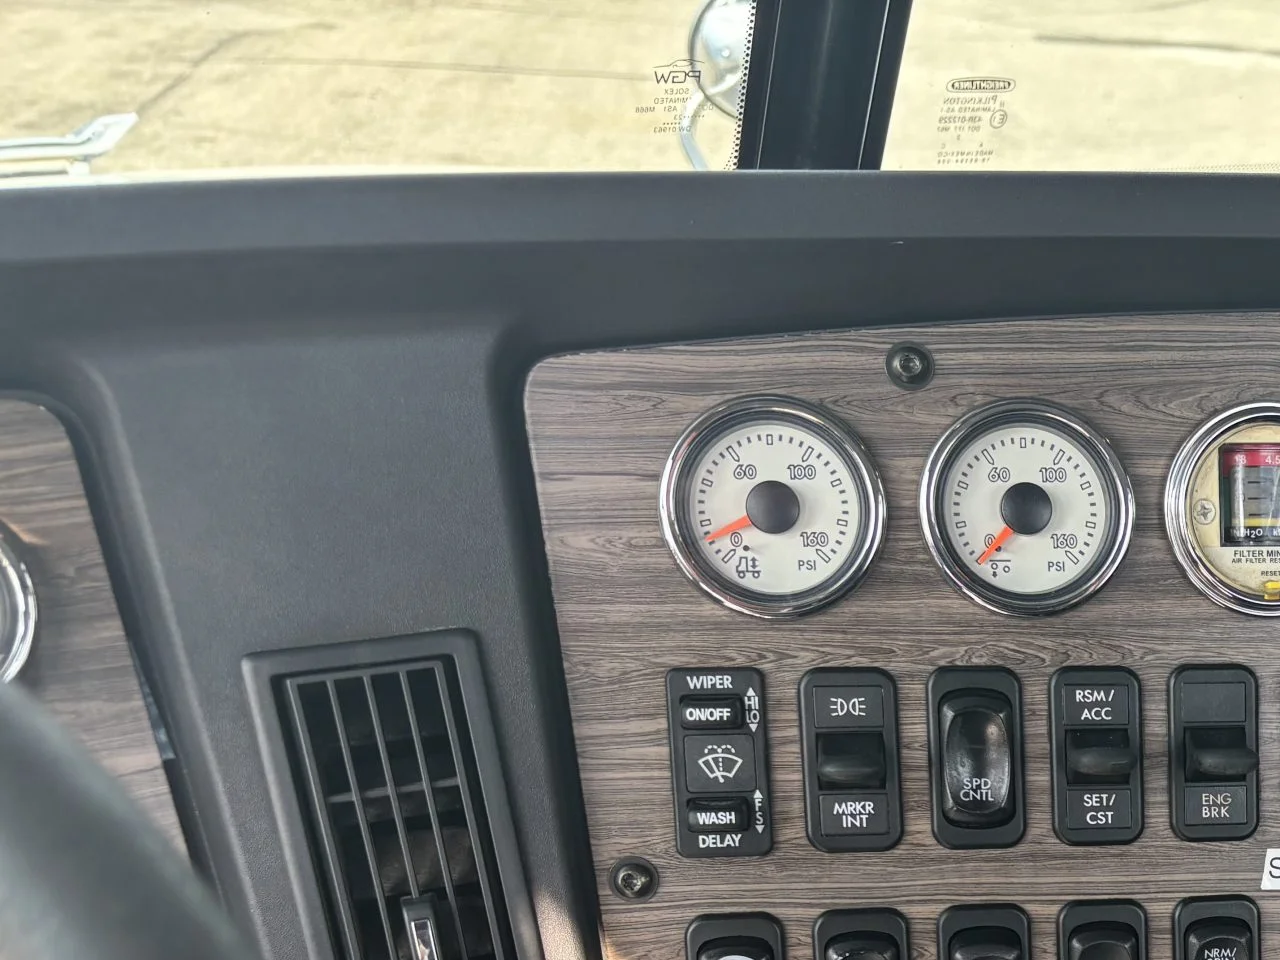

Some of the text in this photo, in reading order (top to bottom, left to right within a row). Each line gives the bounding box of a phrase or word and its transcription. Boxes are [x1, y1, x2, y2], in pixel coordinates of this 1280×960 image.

[1265, 454, 1280, 465] 4.5
[733, 464, 757, 480] 60
[787, 465, 816, 480] 100
[988, 467, 1011, 483] 60
[1040, 468, 1067, 483] 100
[730, 532, 743, 548] 0
[800, 531, 829, 548] 160
[1051, 533, 1078, 549] 160
[1233, 549, 1264, 558] FILTER
[797, 559, 817, 571] PSI
[1048, 561, 1066, 572] PSI
[686, 675, 733, 689] WIPER
[1075, 689, 1115, 703] RSM/
[744, 696, 759, 710] HI
[686, 708, 731, 721] ON/OFF
[746, 711, 760, 724] LO
[1081, 707, 1113, 721] ACC
[963, 777, 992, 790] SPD
[959, 789, 995, 802] CNTL
[1083, 793, 1116, 807] SET/
[1202, 793, 1232, 805] ENG
[833, 801, 875, 815] MRKR
[1202, 806, 1230, 818] BRK
[697, 812, 736, 825] WASH
[842, 815, 869, 828] INT
[1086, 812, 1114, 825] CST
[699, 834, 742, 849] DELAY
[1204, 947, 1237, 960] NRM/
